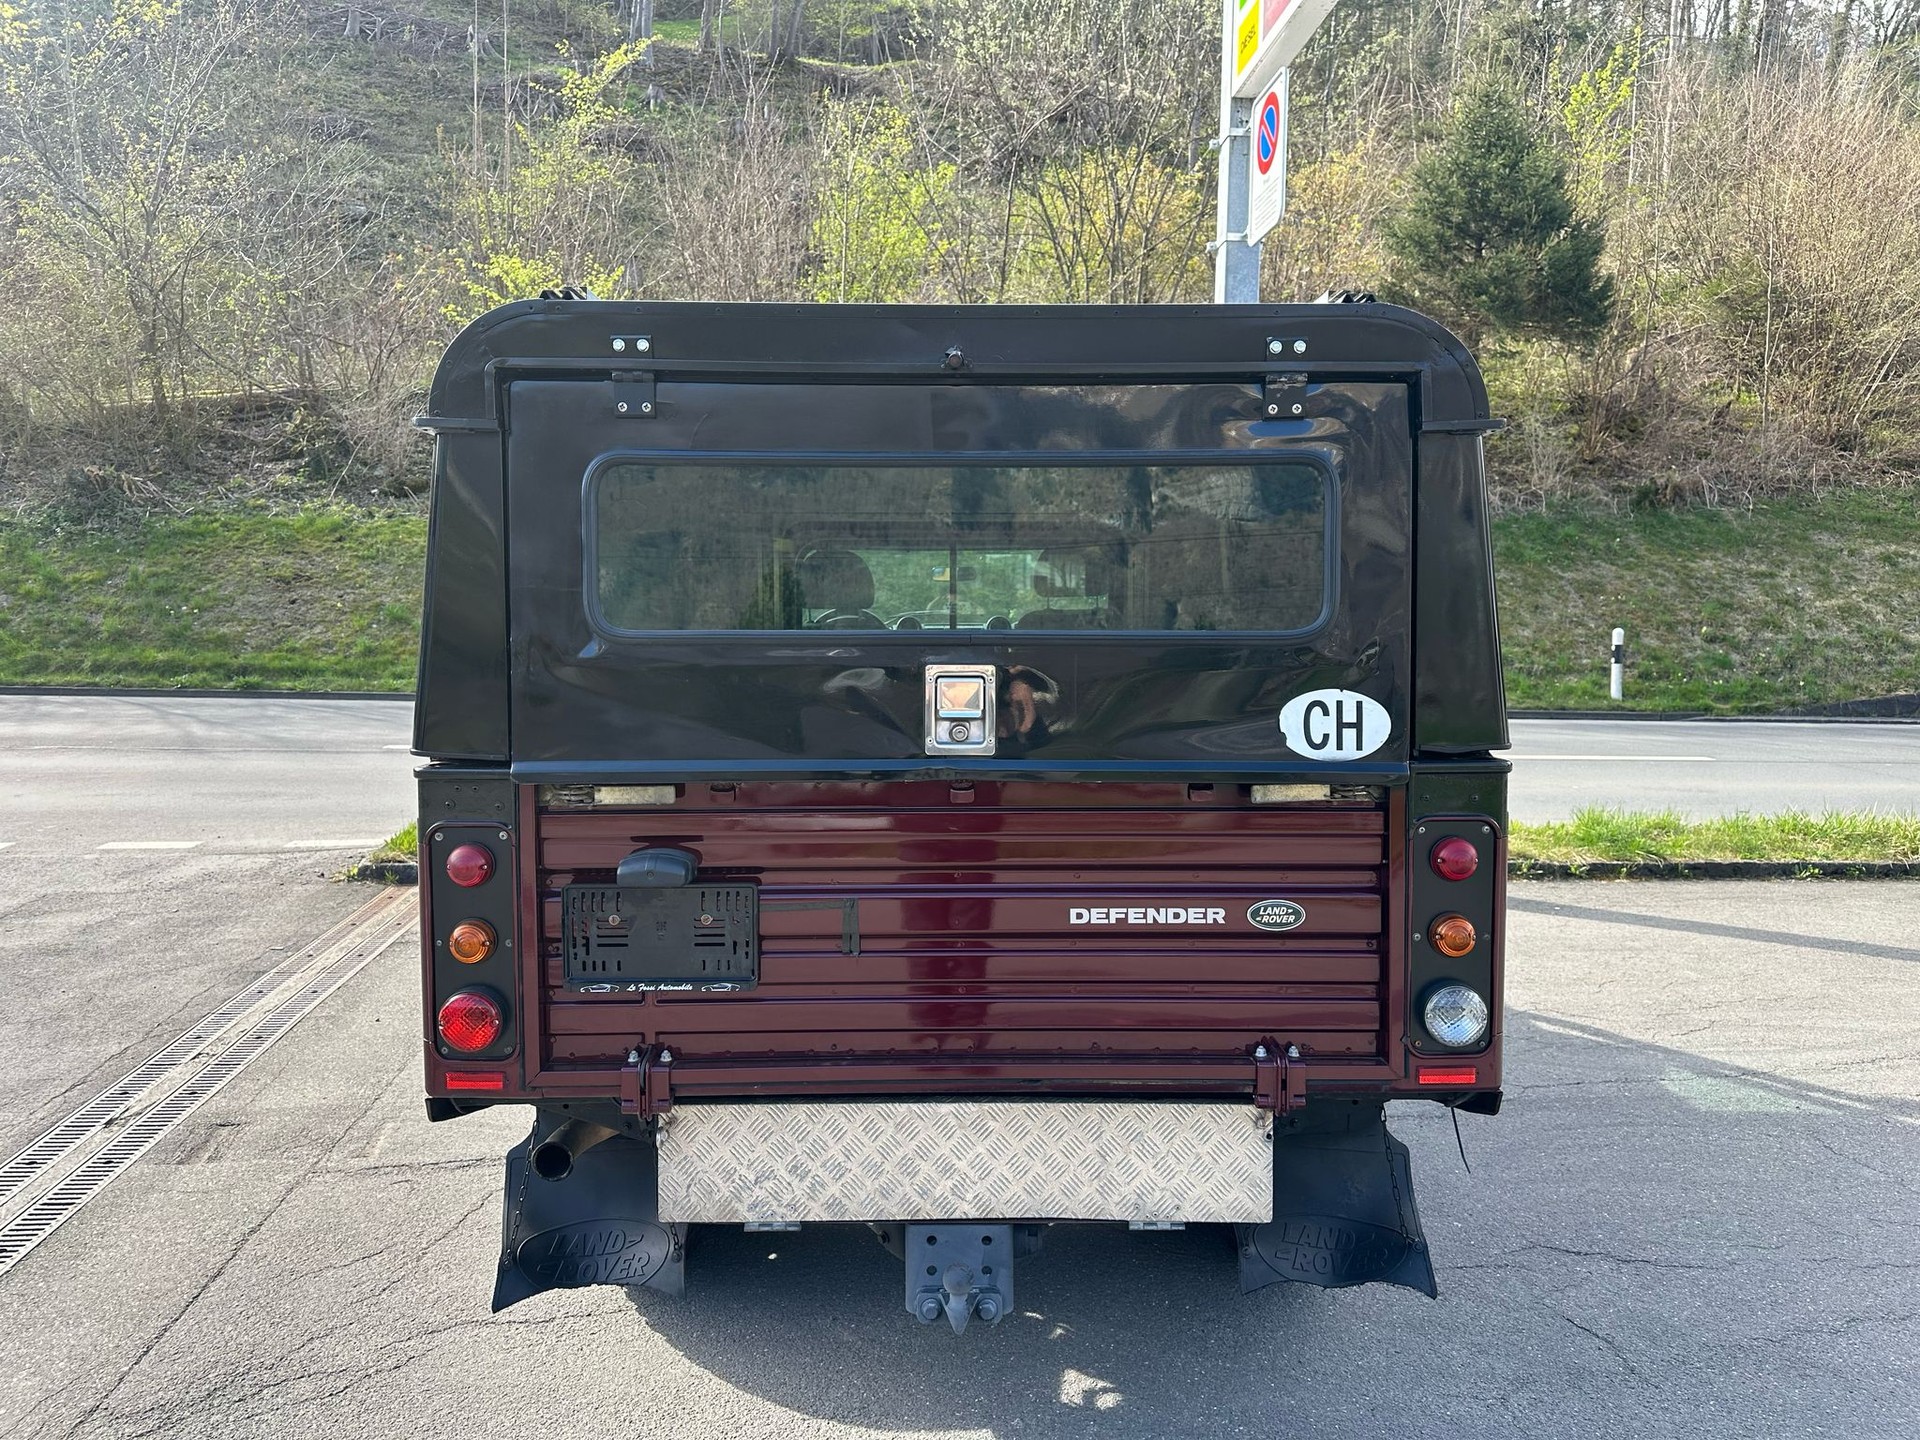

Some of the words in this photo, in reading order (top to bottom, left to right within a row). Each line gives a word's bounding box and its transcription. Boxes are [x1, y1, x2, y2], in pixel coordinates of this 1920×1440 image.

[1303, 699, 1364, 751] CH
[1069, 907, 1226, 925] DEFENDER
[1259, 906, 1288, 915] LAND
[1262, 915, 1296, 924] ROVER
[548, 1228, 627, 1258] LAND
[1281, 1222, 1355, 1250] LAND
[553, 1251, 651, 1283] ROVER
